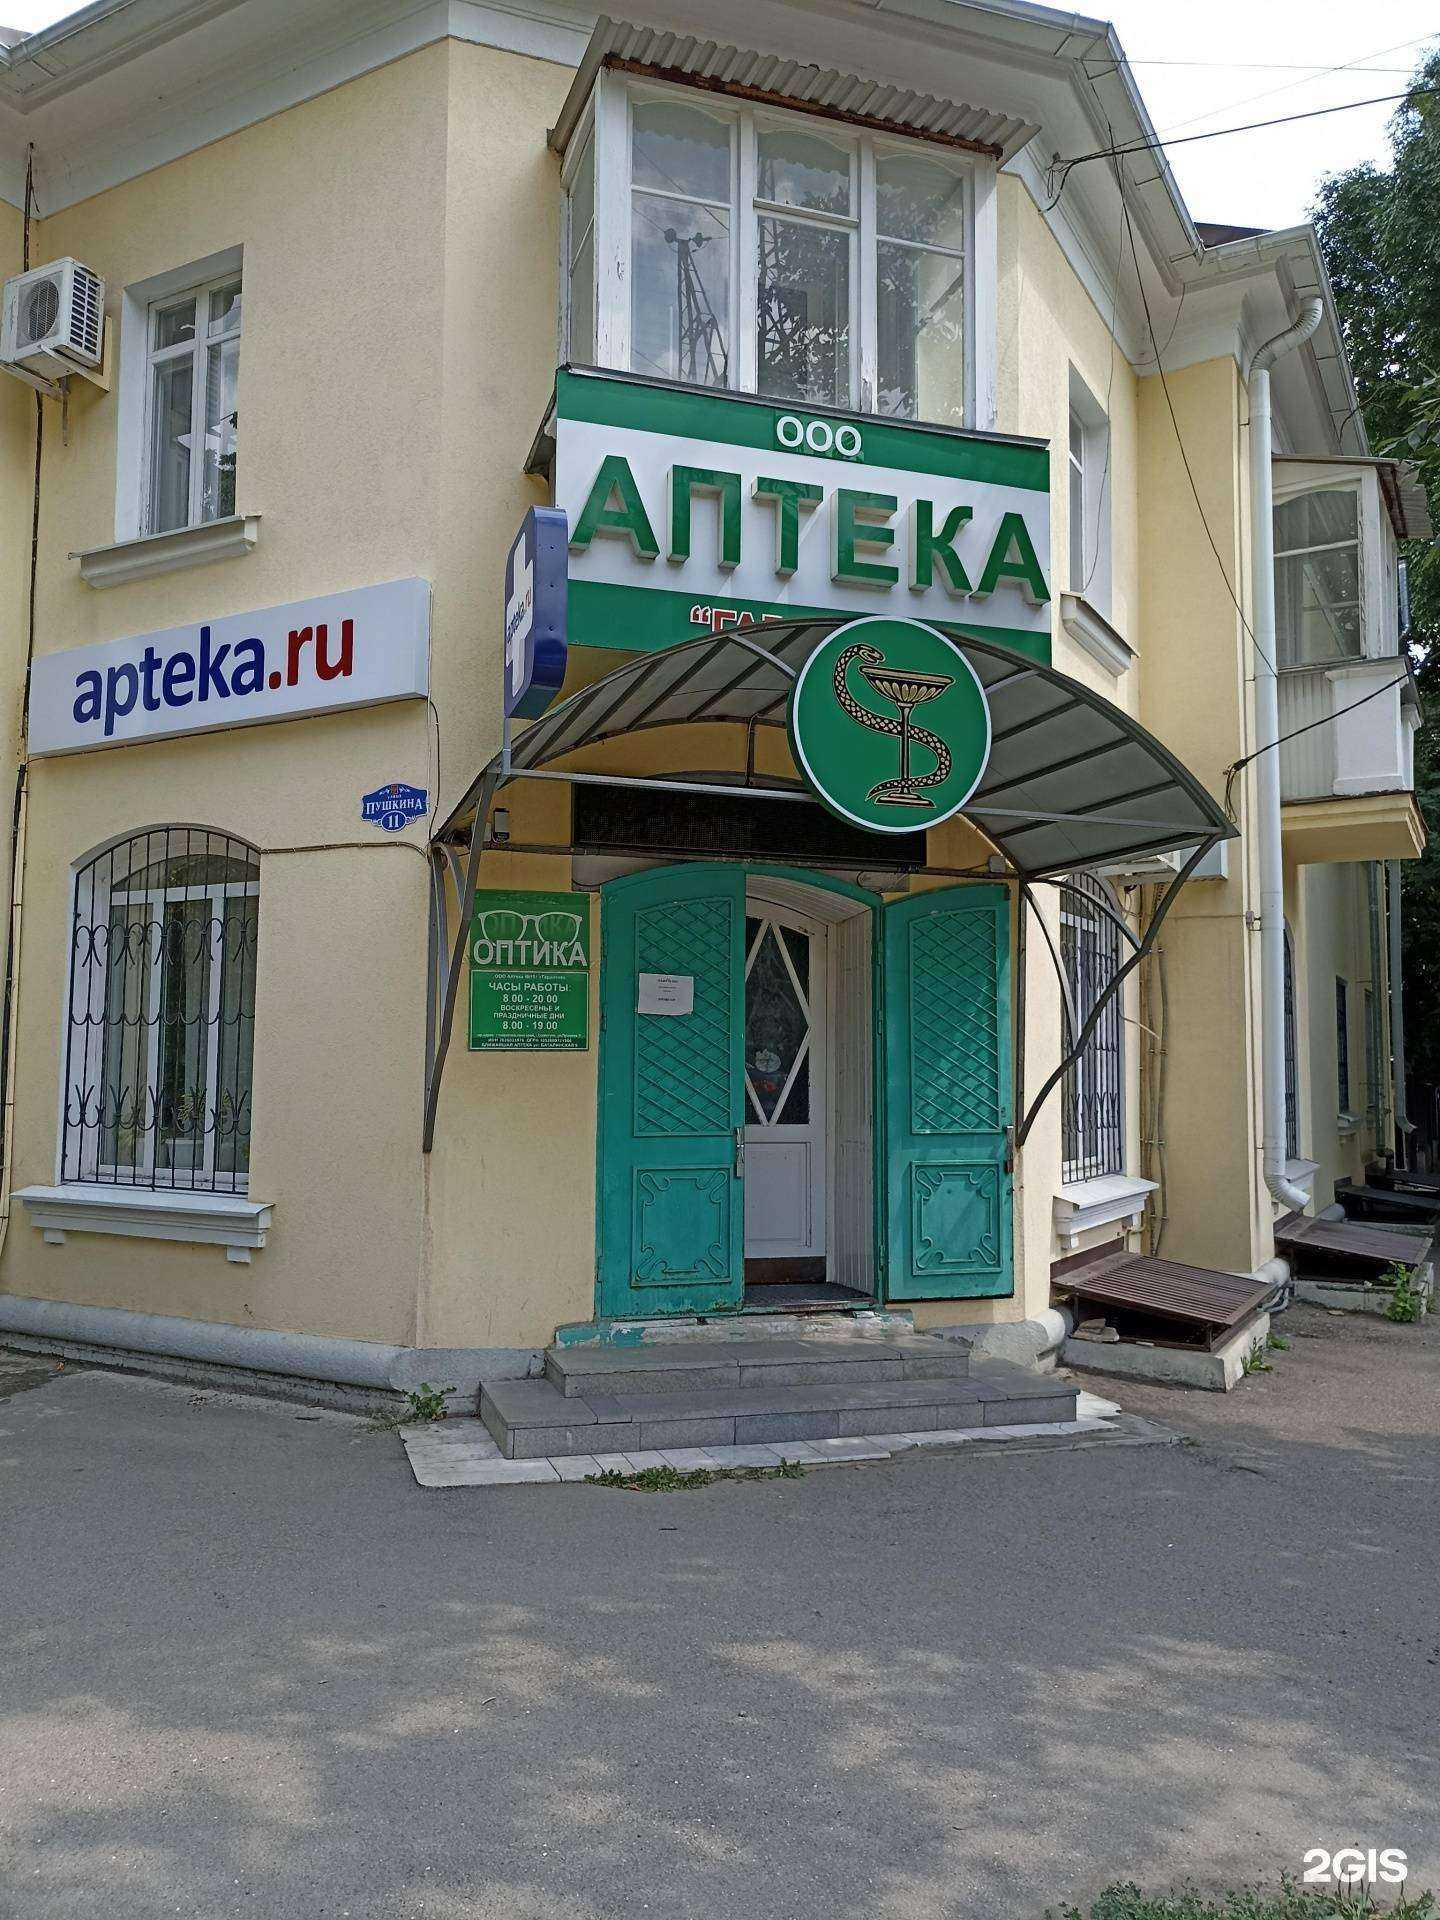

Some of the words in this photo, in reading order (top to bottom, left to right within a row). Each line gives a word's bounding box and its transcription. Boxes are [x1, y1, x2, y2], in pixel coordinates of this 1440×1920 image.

[775, 414, 863, 458] ООО
[568, 454, 1052, 606] АПТЕКА
[72, 618, 355, 736] apteka.ru
[366, 798, 423, 815] ПУШКИНА
[388, 814, 399, 828] 11
[473, 939, 588, 967] ОПТИКА
[488, 982, 521, 991] ЧАСЫ
[502, 993, 523, 1003] 8.00
[532, 993, 558, 1003] 20.00
[500, 1004, 553, 1012] ВОСКРЕСЕНЬЕ
[549, 1012, 565, 1020] ДНИ
[502, 1020, 523, 1030] 8.00
[532, 1020, 558, 1030] 19.00
